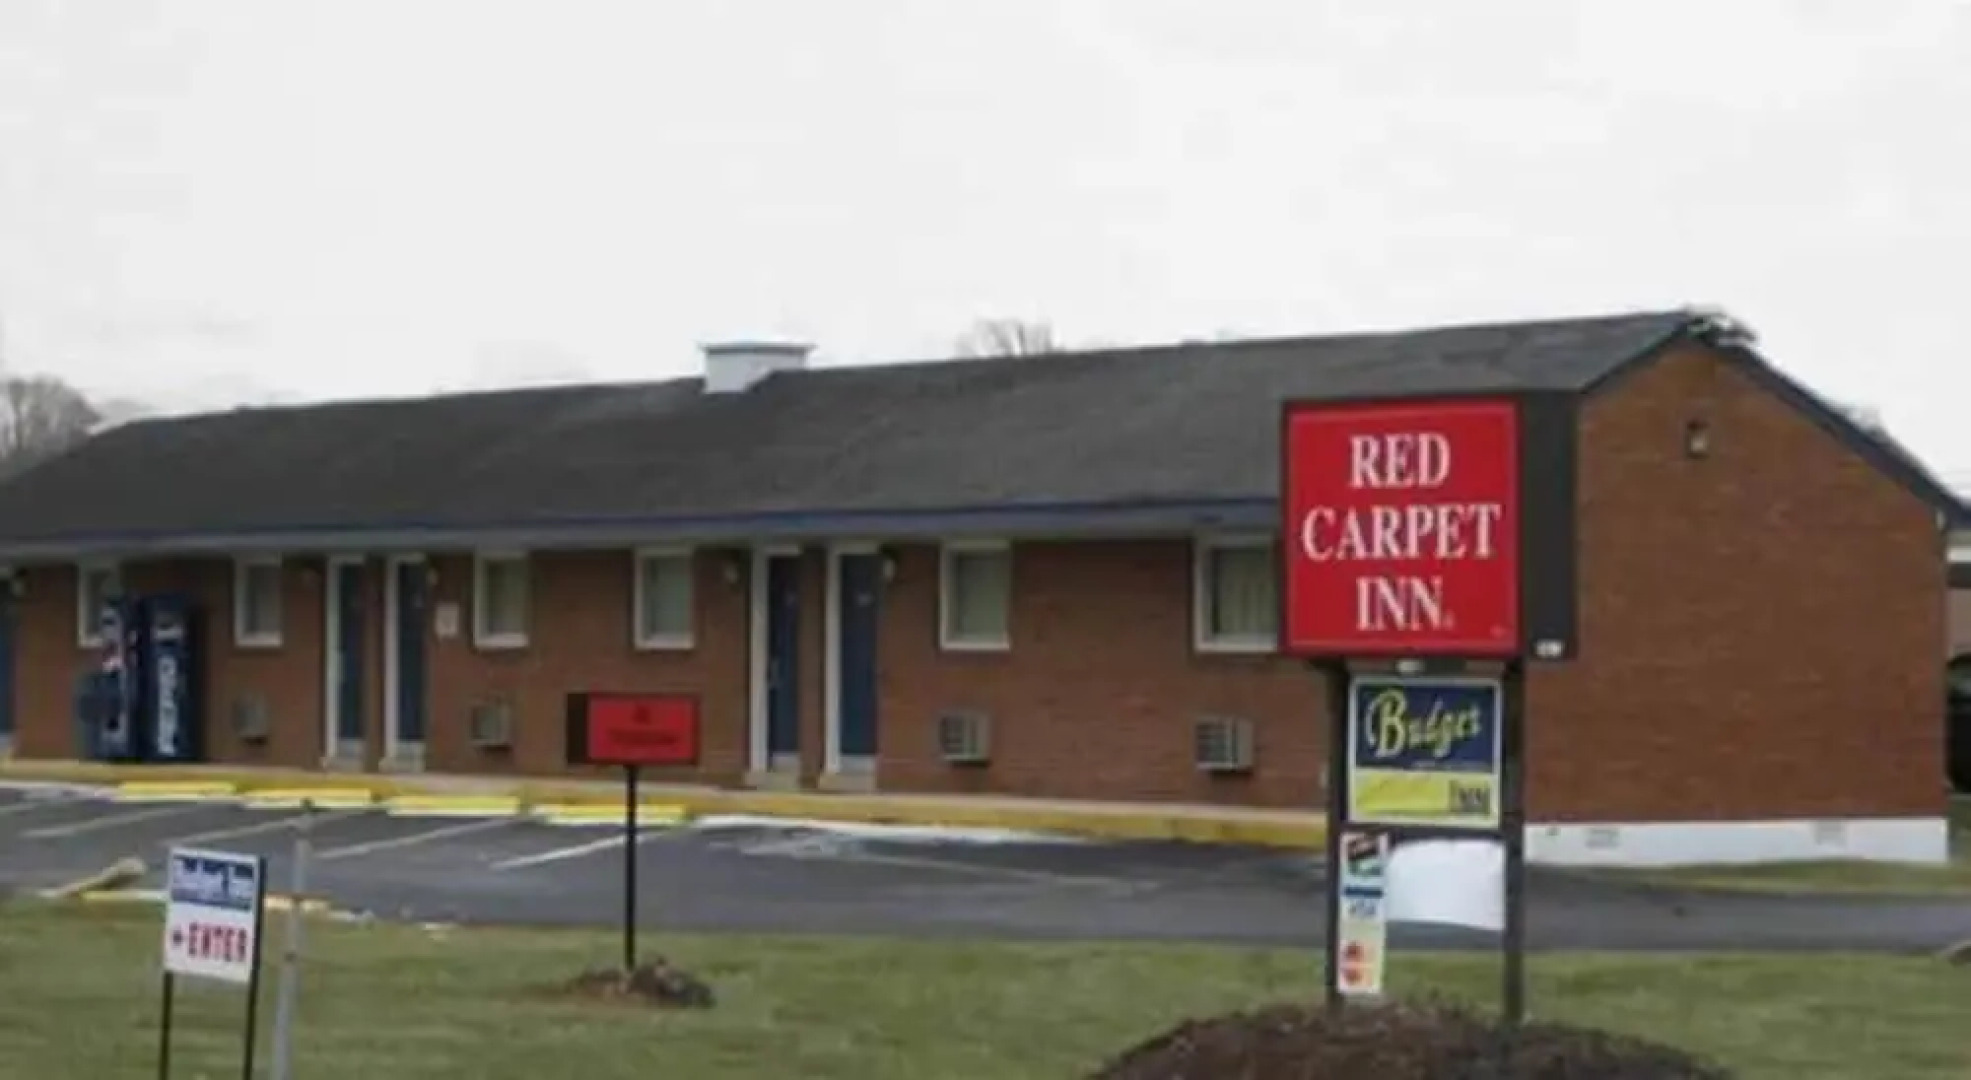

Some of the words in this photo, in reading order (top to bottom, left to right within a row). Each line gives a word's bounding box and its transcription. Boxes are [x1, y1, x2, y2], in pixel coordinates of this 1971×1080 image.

[1350, 433, 1450, 489] RED
[1302, 504, 1501, 561] CARPET
[1355, 576, 1443, 631] INN
[188, 922, 247, 962] ENTER
